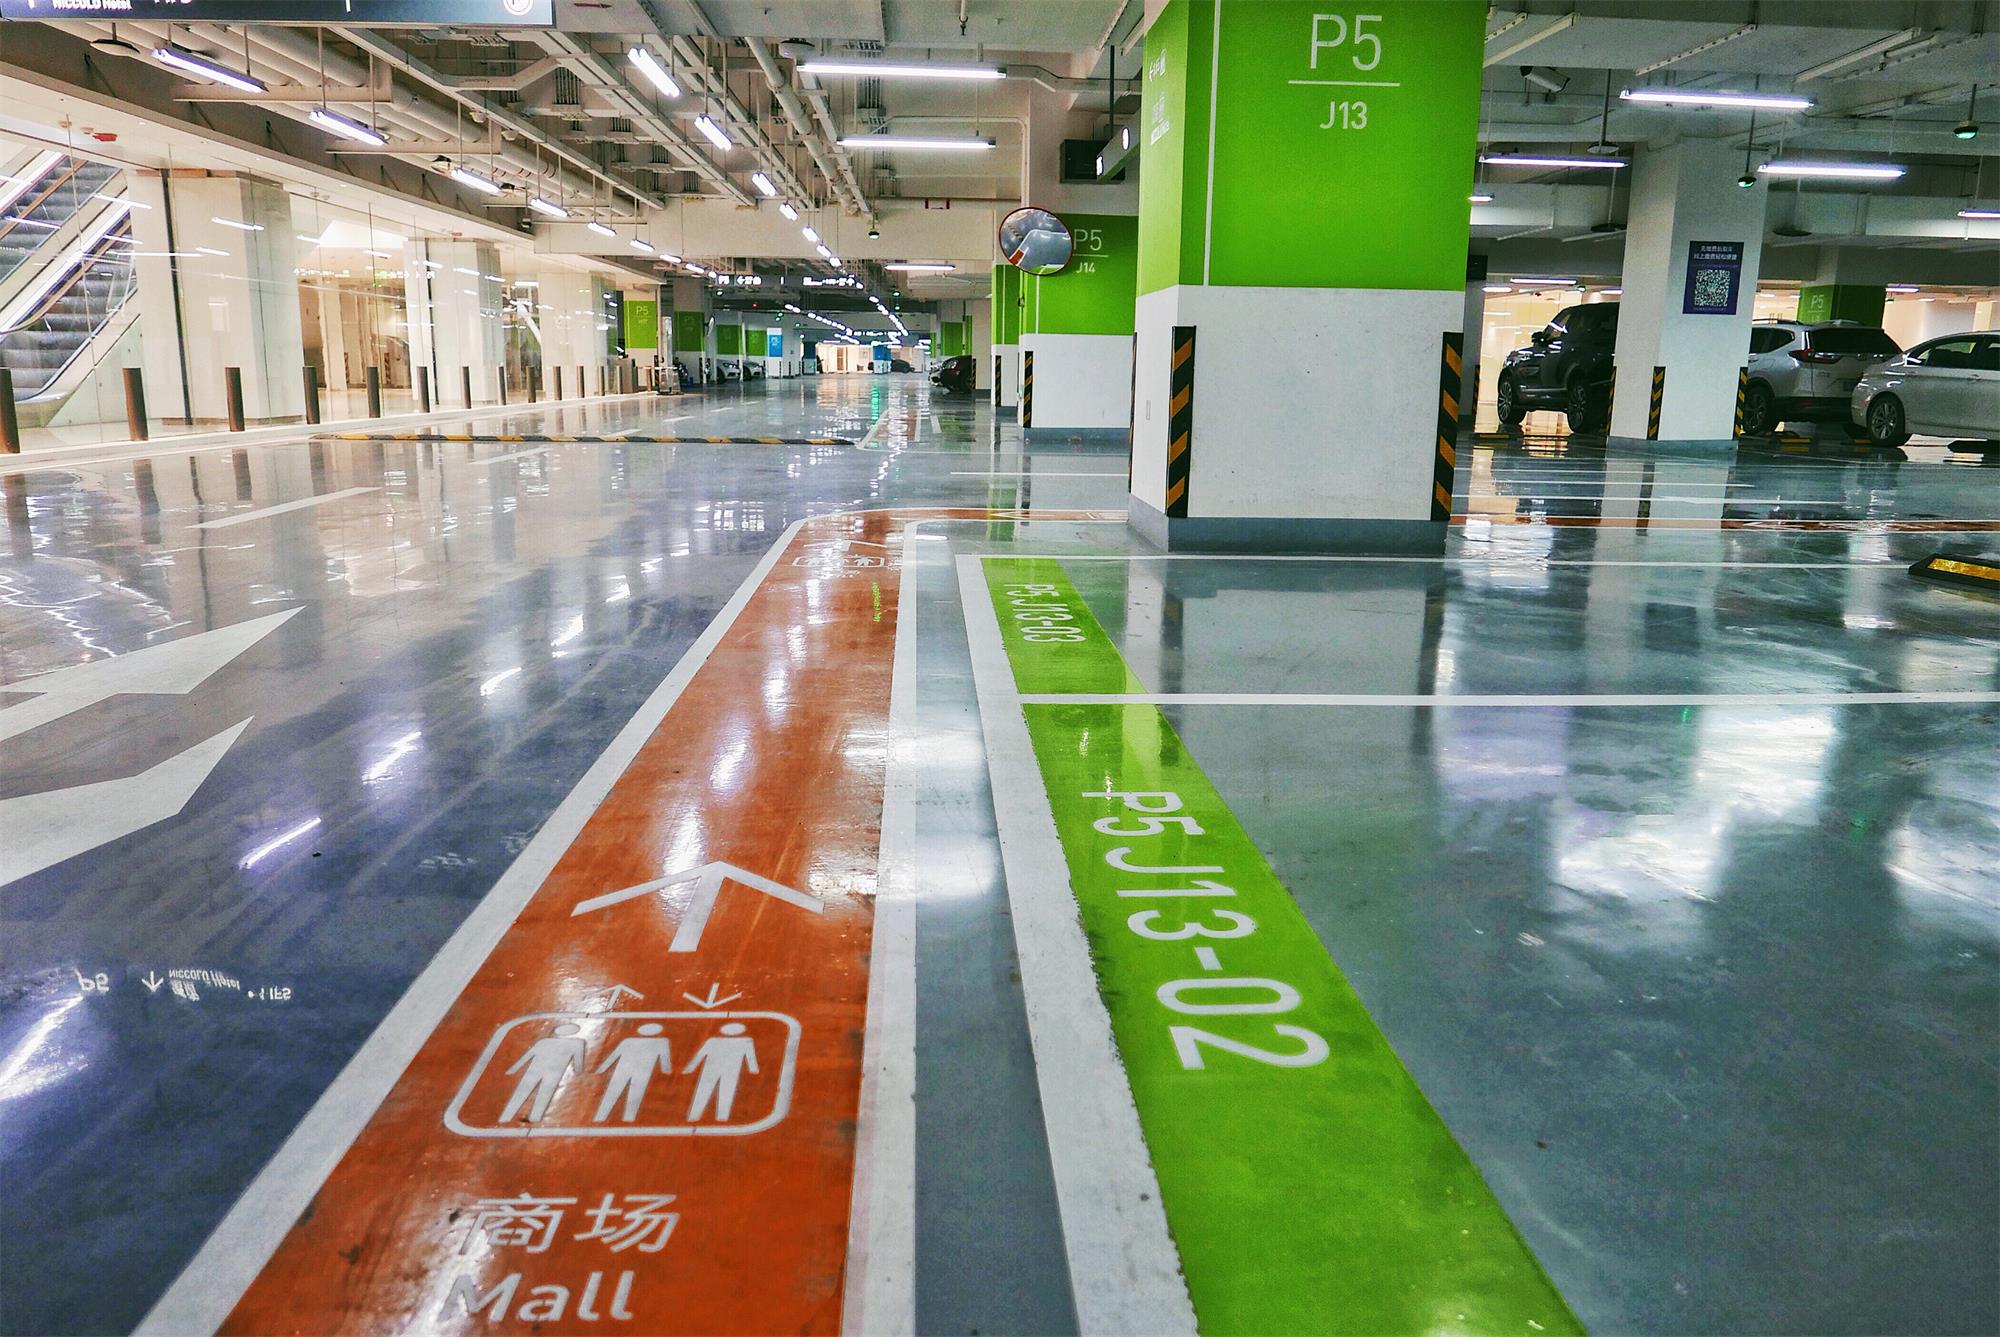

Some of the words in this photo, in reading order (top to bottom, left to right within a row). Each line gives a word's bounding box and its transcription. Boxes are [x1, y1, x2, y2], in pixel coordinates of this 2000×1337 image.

[1310, 14, 1382, 71] P5
[1320, 100, 1368, 129] J13
[1073, 228, 1102, 251] P5
[1075, 262, 1096, 273] J14
[636, 305, 649, 316] P5
[1003, 584, 1060, 597] P5
[1010, 599, 1086, 643] J13-03
[1081, 791, 1205, 837] P5
[1104, 846, 1330, 1070] J13-02
[458, 1192, 680, 1254] 商场
[438, 1270, 635, 1323] Mall
